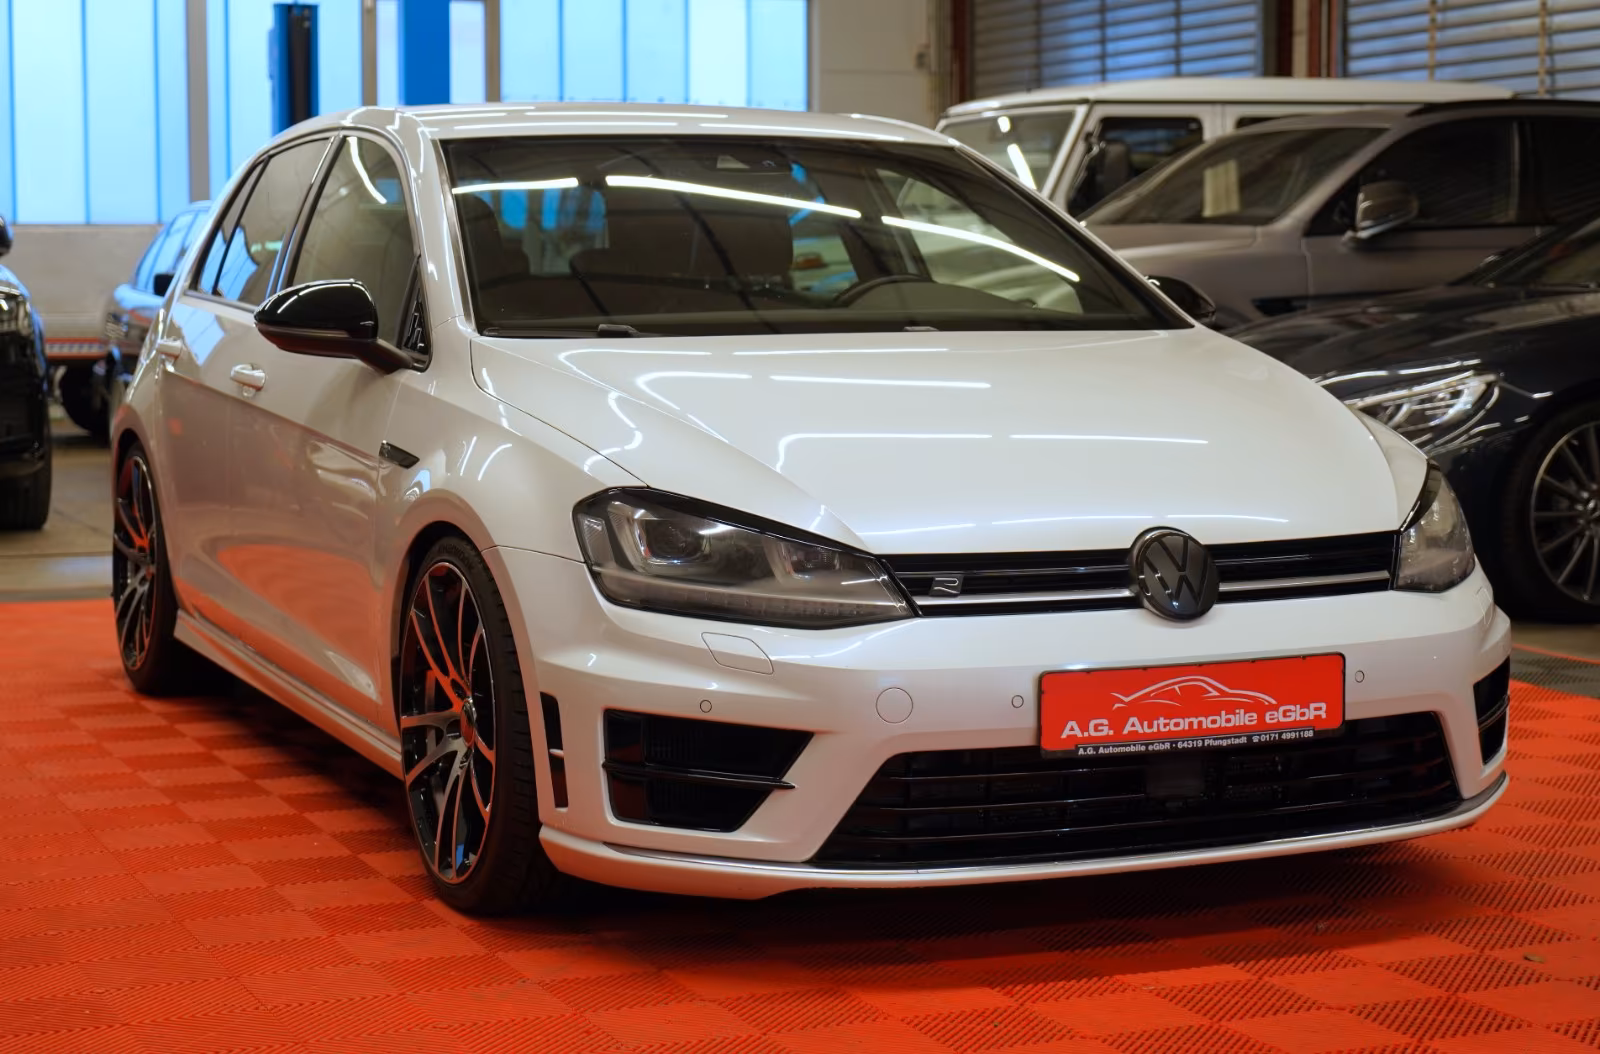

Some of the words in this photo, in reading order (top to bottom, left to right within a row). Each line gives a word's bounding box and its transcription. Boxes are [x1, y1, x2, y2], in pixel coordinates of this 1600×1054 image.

[1060, 718, 1115, 739] A.G.
[1122, 709, 1258, 735] Automobile
[1265, 702, 1327, 724] eGbR
[1078, 747, 1097, 756] A.G.
[1098, 743, 1146, 754] Automobile
[1148, 742, 1171, 751] eGbR
[1177, 739, 1203, 749] 64319
[1204, 735, 1248, 747] Pfungstadt
[1260, 732, 1279, 742] 0171
[1281, 730, 1314, 740] 4991188
